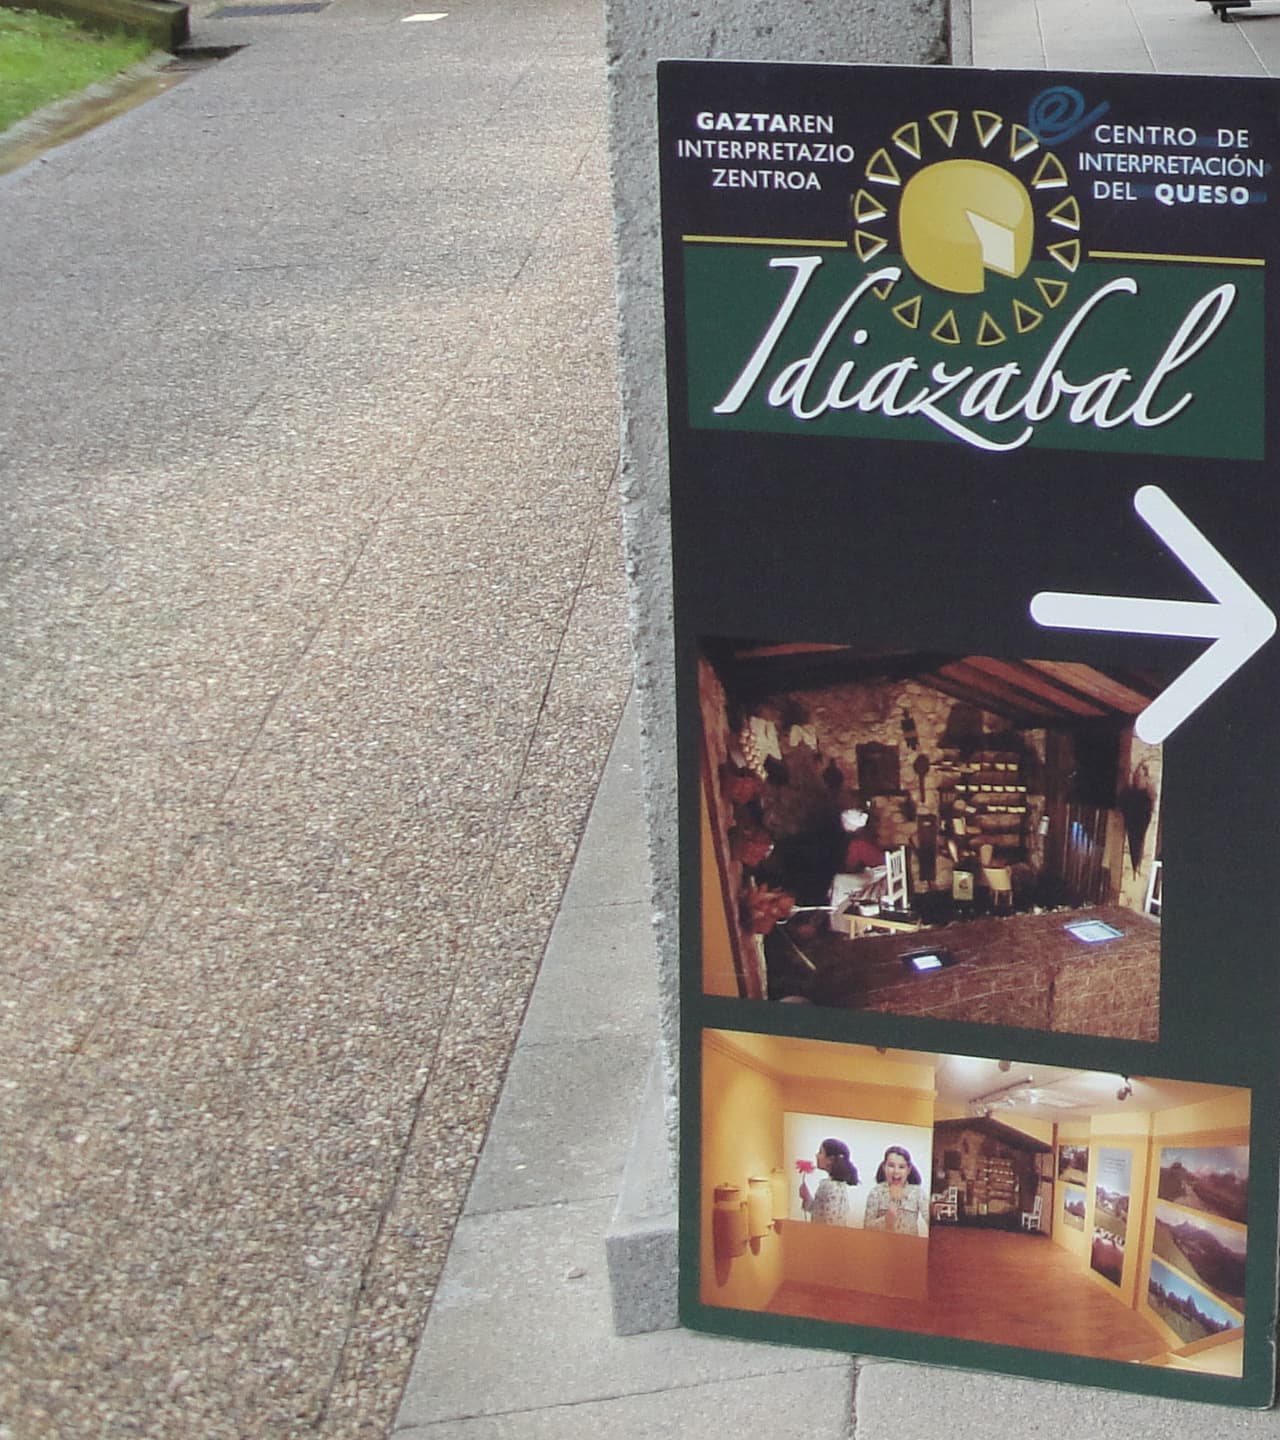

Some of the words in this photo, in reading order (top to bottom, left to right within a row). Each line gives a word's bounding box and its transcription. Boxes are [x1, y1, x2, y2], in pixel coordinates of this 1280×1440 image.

[696, 111, 834, 135] GAZTAREN
[1094, 124, 1197, 147] CENTRO
[1217, 128, 1250, 148] DE
[677, 139, 855, 164] INTERPRETAZIO
[1078, 151, 1265, 178] INTERPRETACIÓN
[711, 168, 822, 191] ZENTROA
[1093, 180, 1138, 201] DEL
[1154, 183, 1250, 206] QUESO
[713, 255, 1237, 453] Idiazabal
